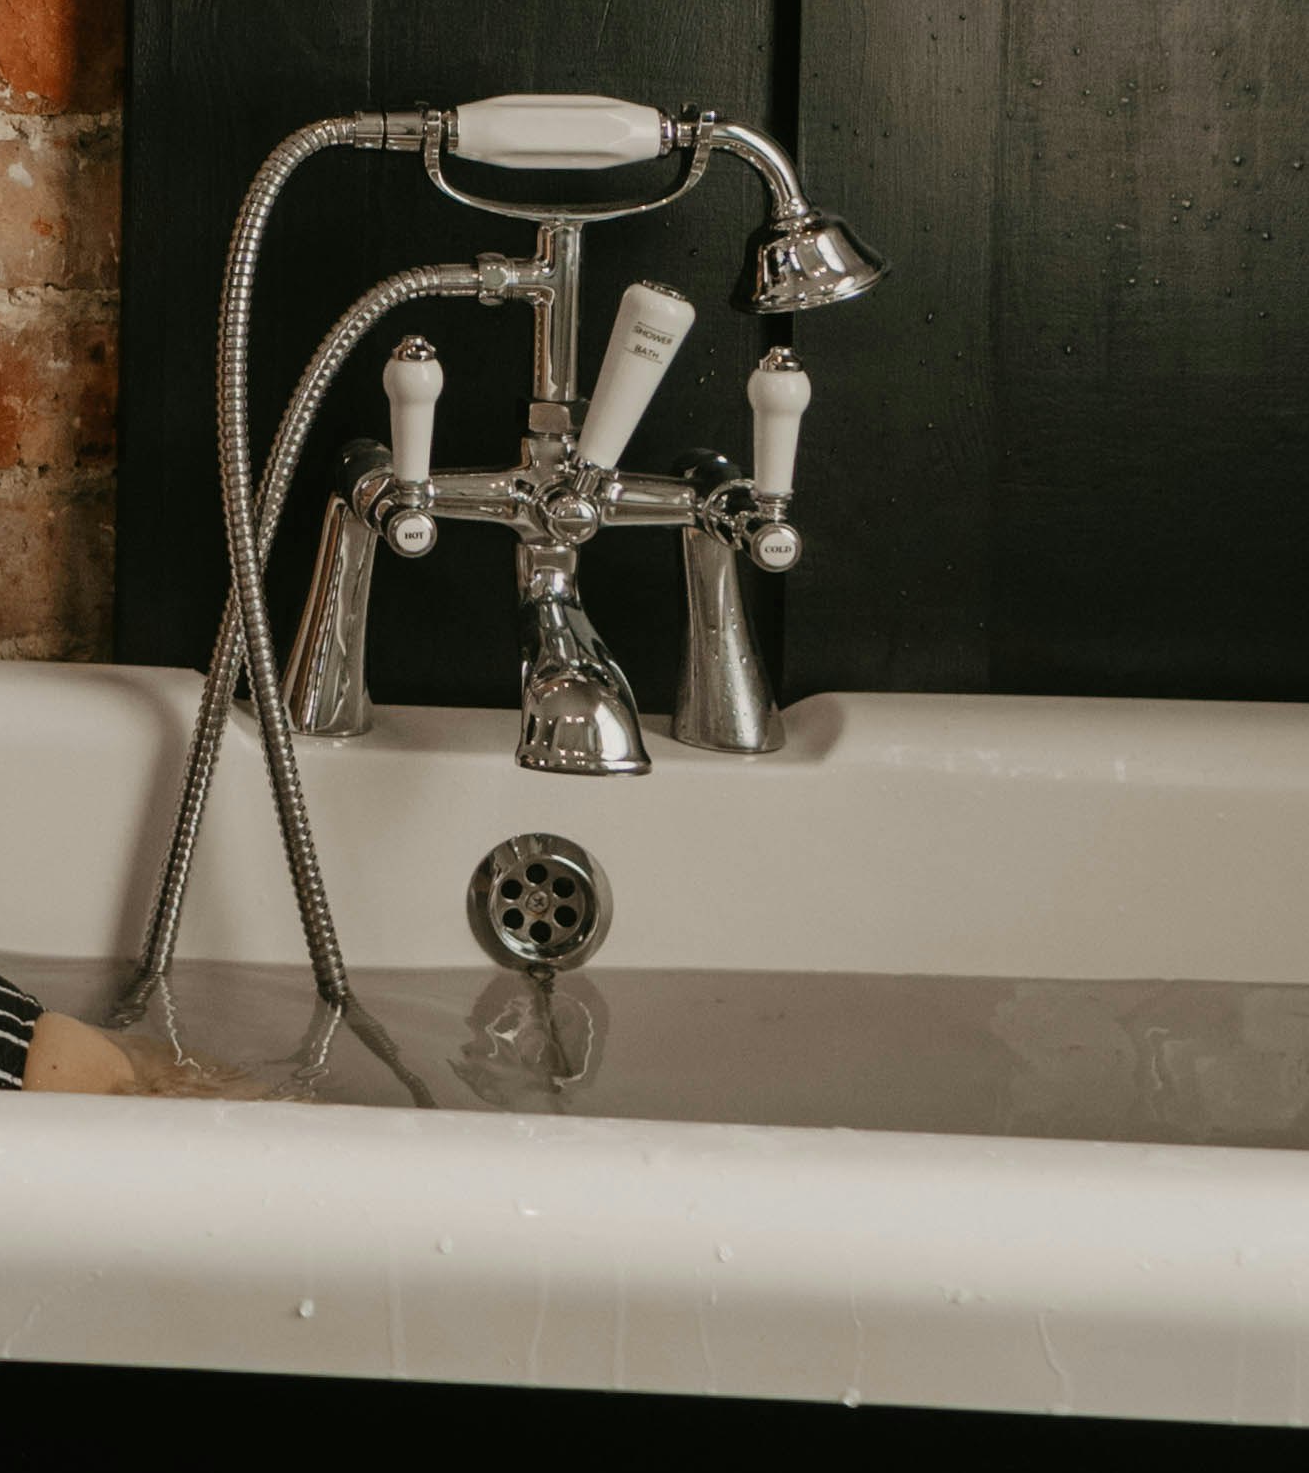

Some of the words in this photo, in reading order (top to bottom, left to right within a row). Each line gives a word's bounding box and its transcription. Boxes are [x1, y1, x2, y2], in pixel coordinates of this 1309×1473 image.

[631, 325, 673, 345] SHOWER
[634, 343, 660, 360] BATH
[404, 531, 424, 540] HOT
[764, 545, 792, 554] COLD
